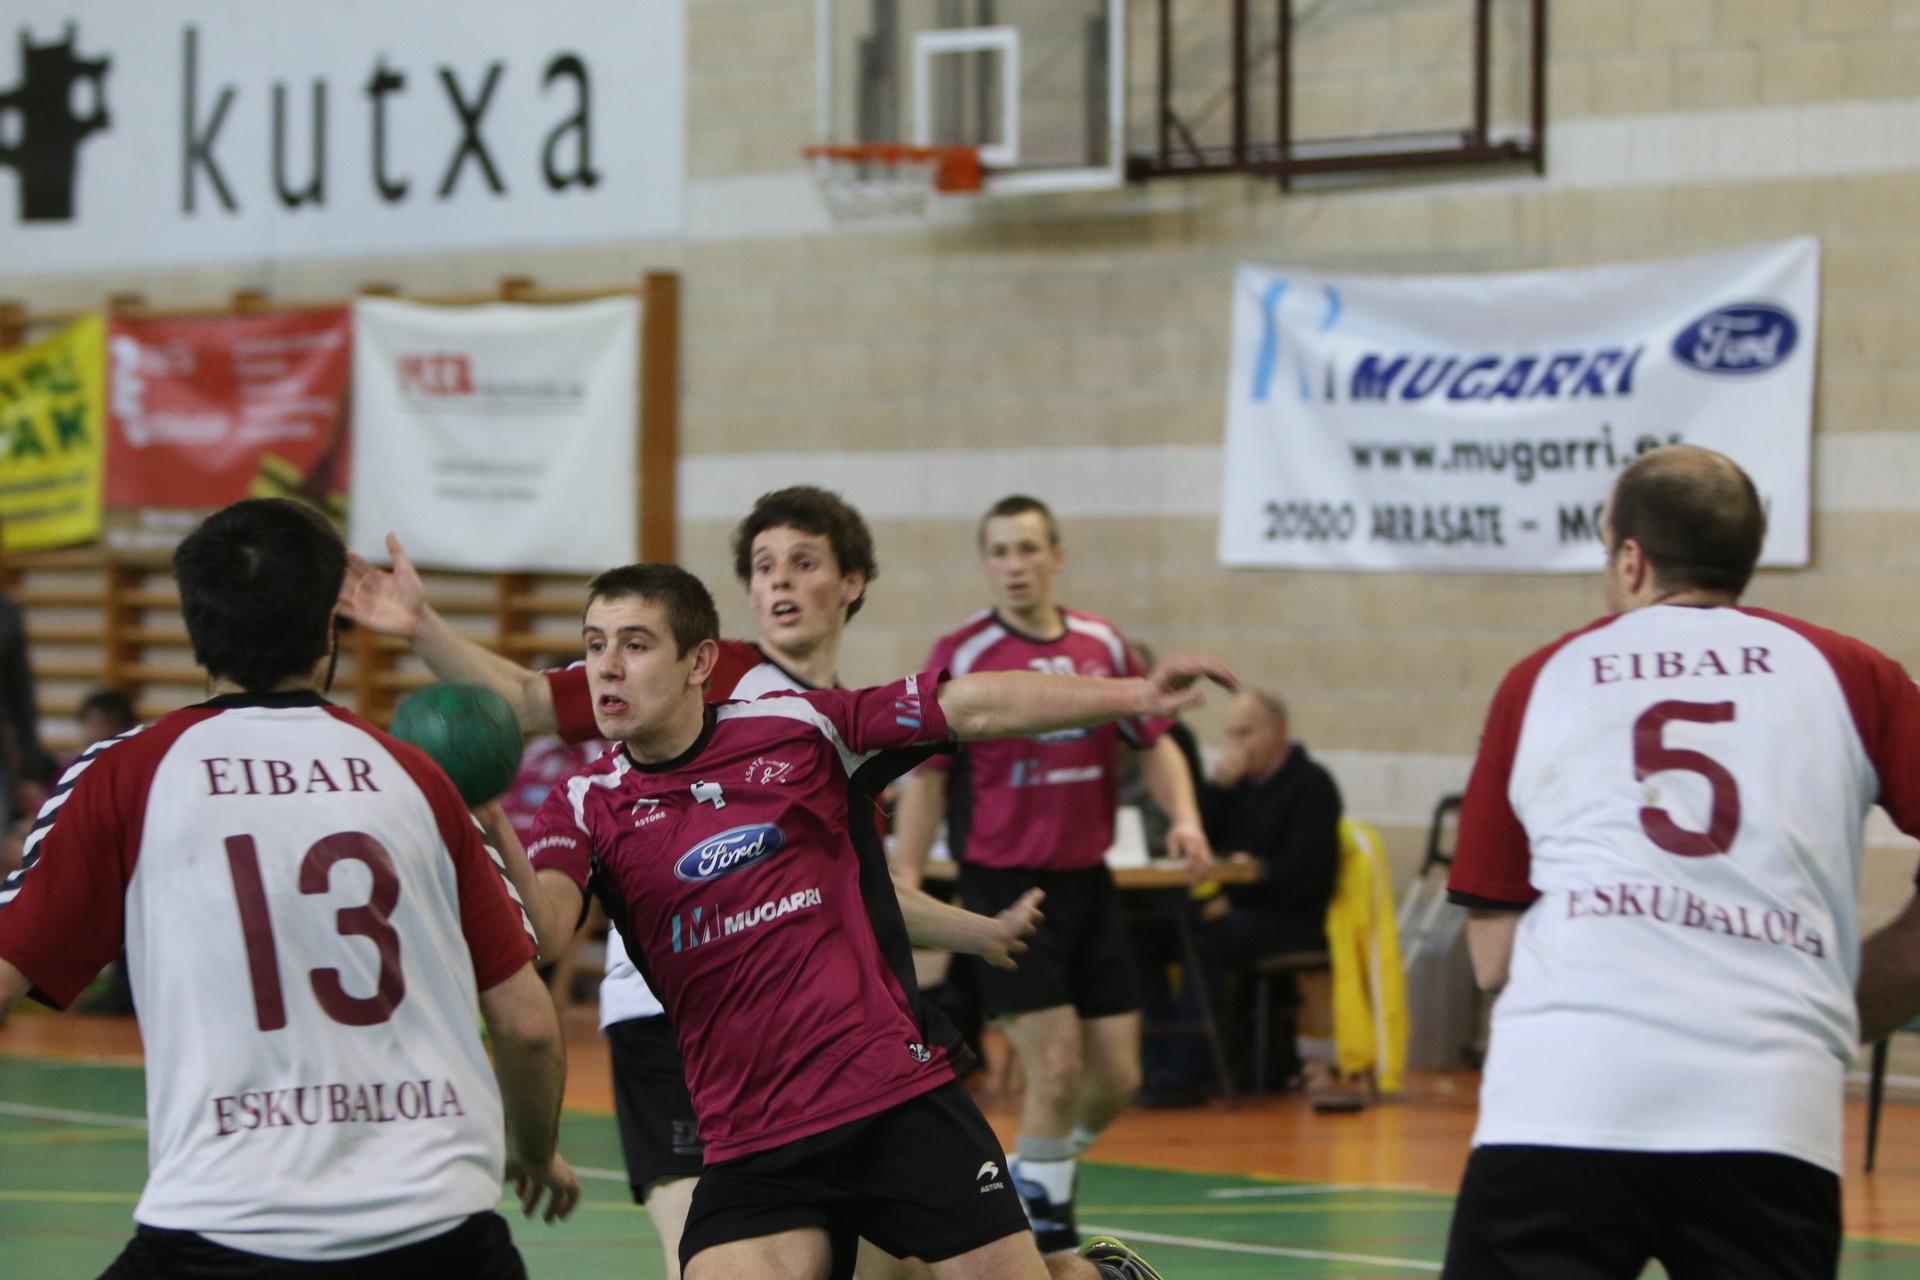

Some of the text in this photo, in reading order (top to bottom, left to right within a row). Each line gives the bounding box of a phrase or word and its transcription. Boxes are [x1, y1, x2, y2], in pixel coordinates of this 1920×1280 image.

[181, 24, 601, 217] kutxa
[1349, 345, 1646, 401] MUGARRI
[1591, 646, 1774, 685] EIBAR
[201, 757, 381, 796] EIBAR
[1633, 699, 1742, 859] 5
[634, 810, 667, 828] ASTORE
[698, 831, 766, 877] Ford
[224, 830, 406, 1033] 13
[724, 887, 823, 937] MUGARRI
[1566, 882, 1826, 959] ESKUBALOIA
[212, 1079, 466, 1138] ESKUBALOIA
